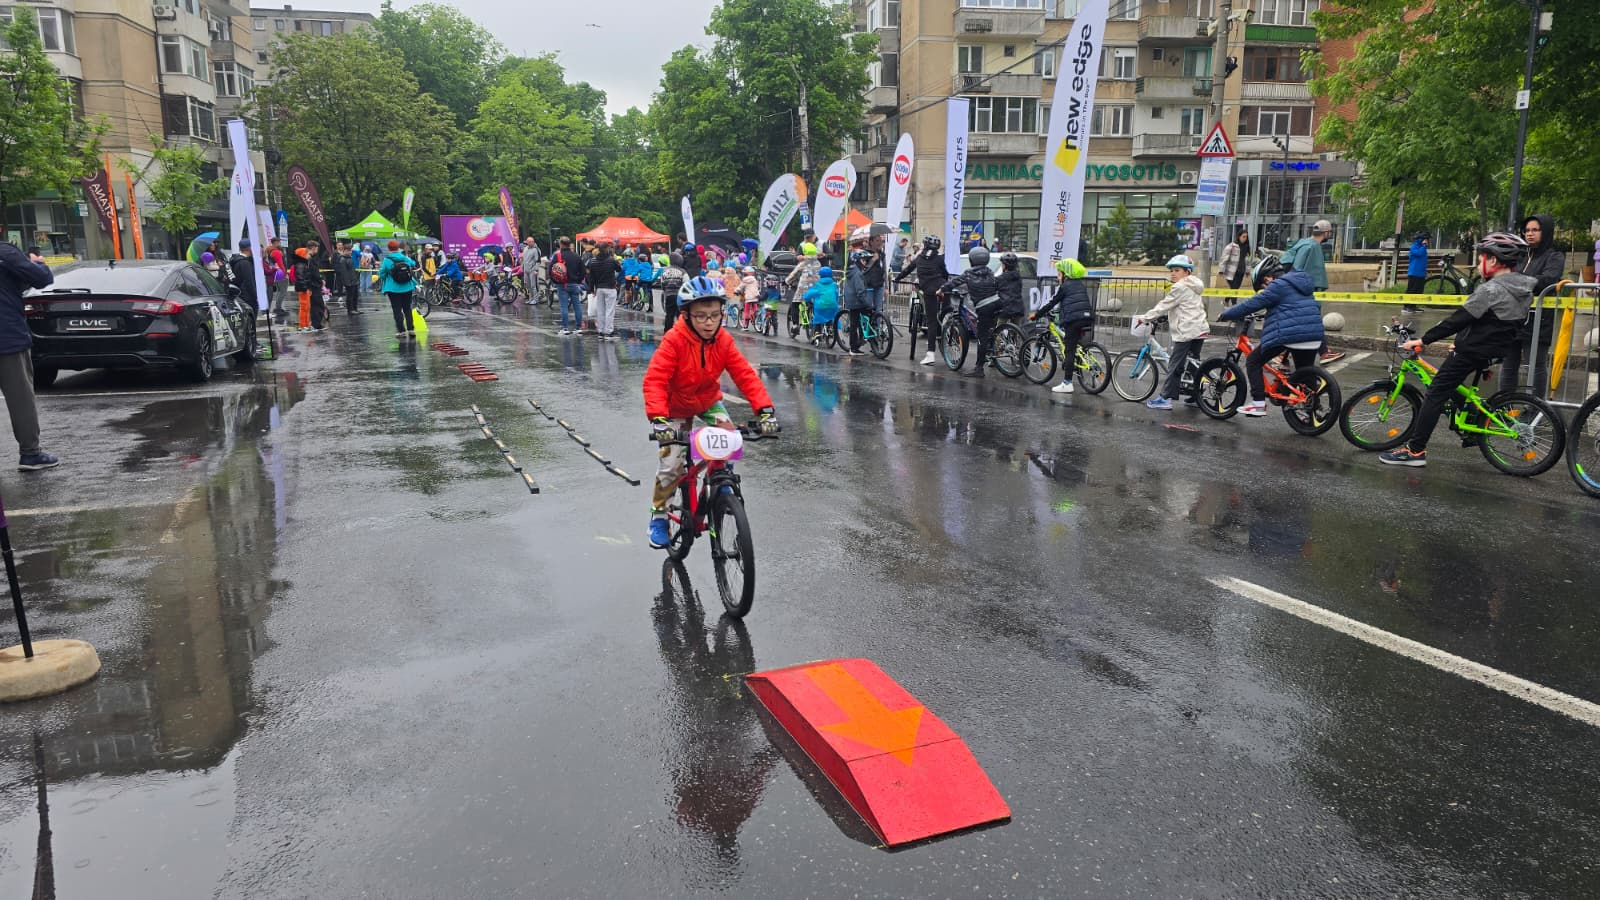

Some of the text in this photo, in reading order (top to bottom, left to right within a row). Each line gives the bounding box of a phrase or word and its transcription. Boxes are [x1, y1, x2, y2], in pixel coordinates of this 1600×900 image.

[1065, 24, 1093, 150] new edge
[965, 163, 1043, 180] FARMAC
[762, 189, 789, 230] DAILY
[69, 319, 109, 327] CIVIC
[706, 435, 728, 449] 126
